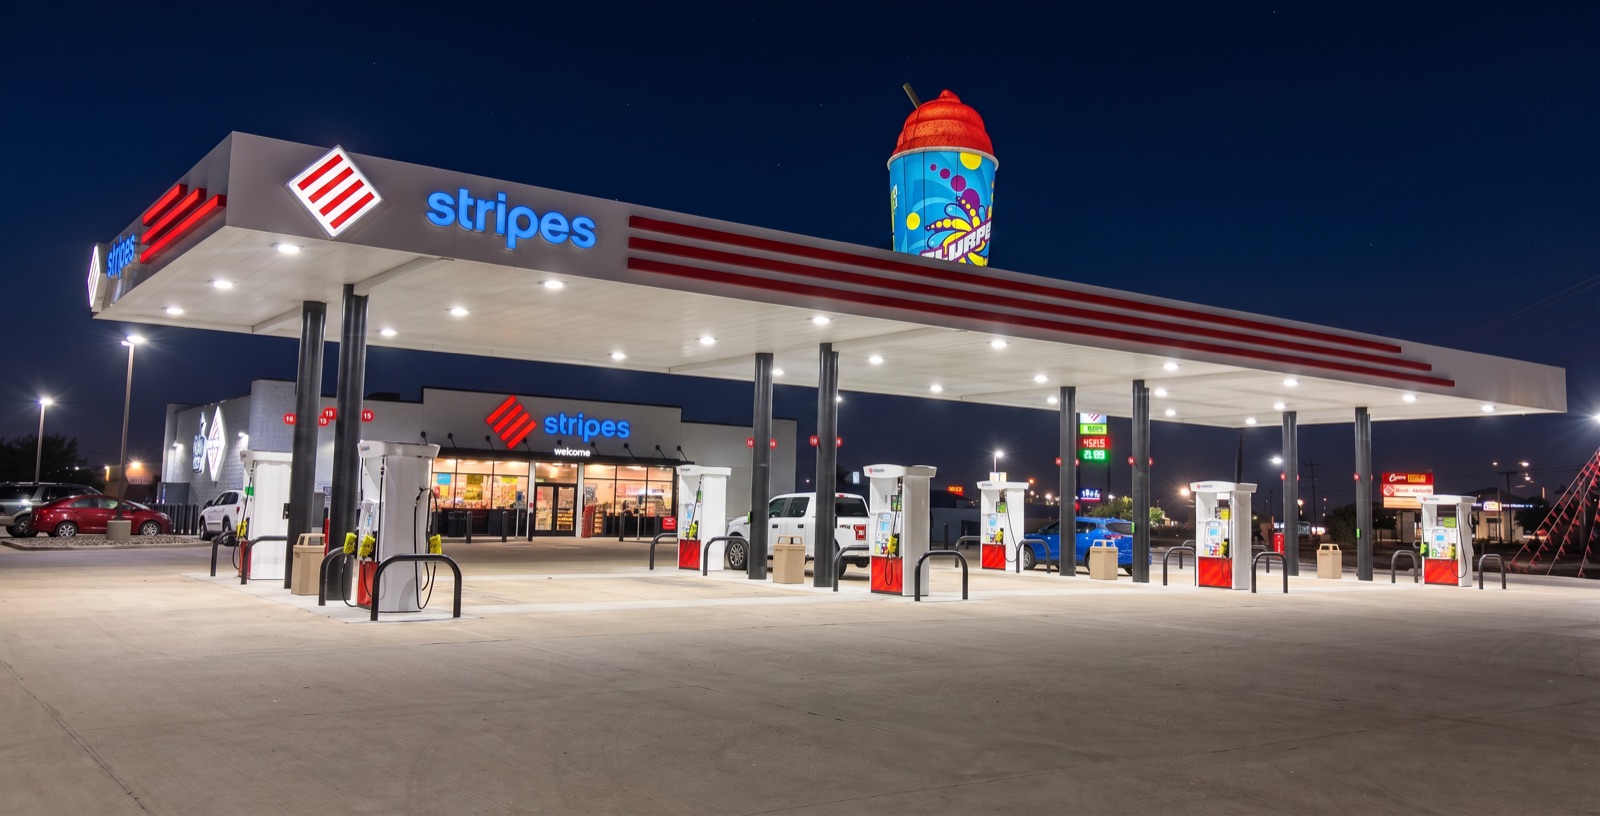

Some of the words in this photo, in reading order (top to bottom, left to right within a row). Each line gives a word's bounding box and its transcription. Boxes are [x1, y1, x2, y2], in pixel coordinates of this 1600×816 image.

[426, 188, 597, 249] stripes
[107, 234, 135, 279] stripes
[544, 412, 631, 443] stripes
[554, 447, 591, 458] welcome
